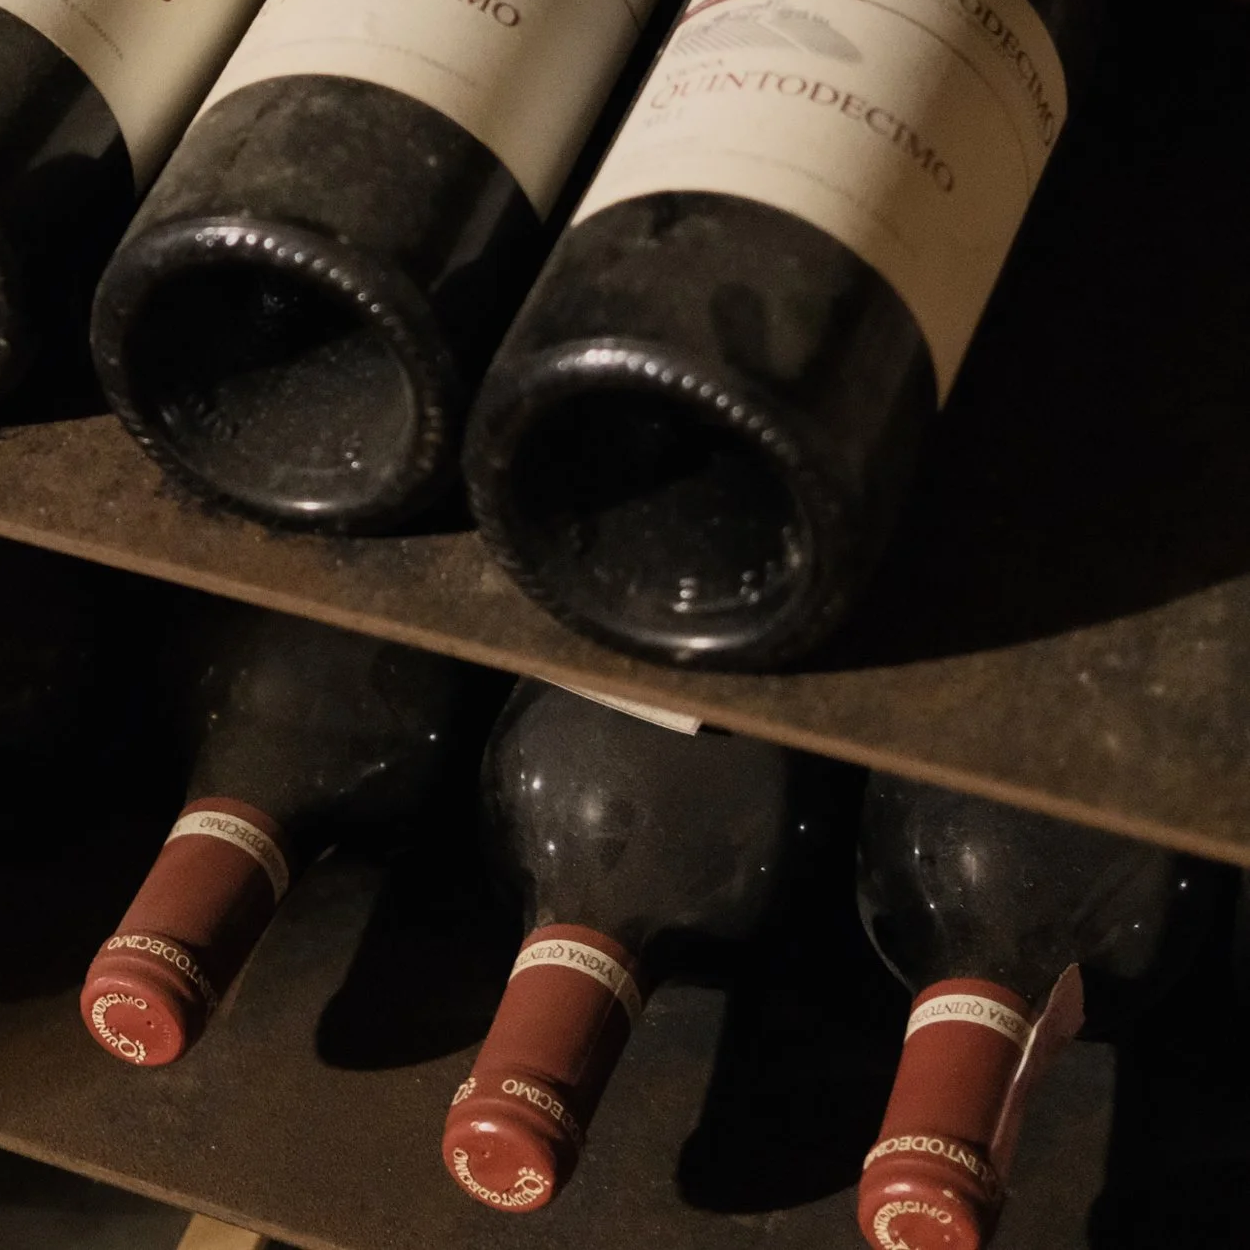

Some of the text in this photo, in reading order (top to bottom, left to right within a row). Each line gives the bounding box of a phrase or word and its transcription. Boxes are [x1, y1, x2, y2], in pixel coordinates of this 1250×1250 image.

[649, 68, 954, 192] QUINTODECIMO
[569, 948, 615, 983] VIGNA
[453, 1147, 544, 1208] QUINTODECIMO
